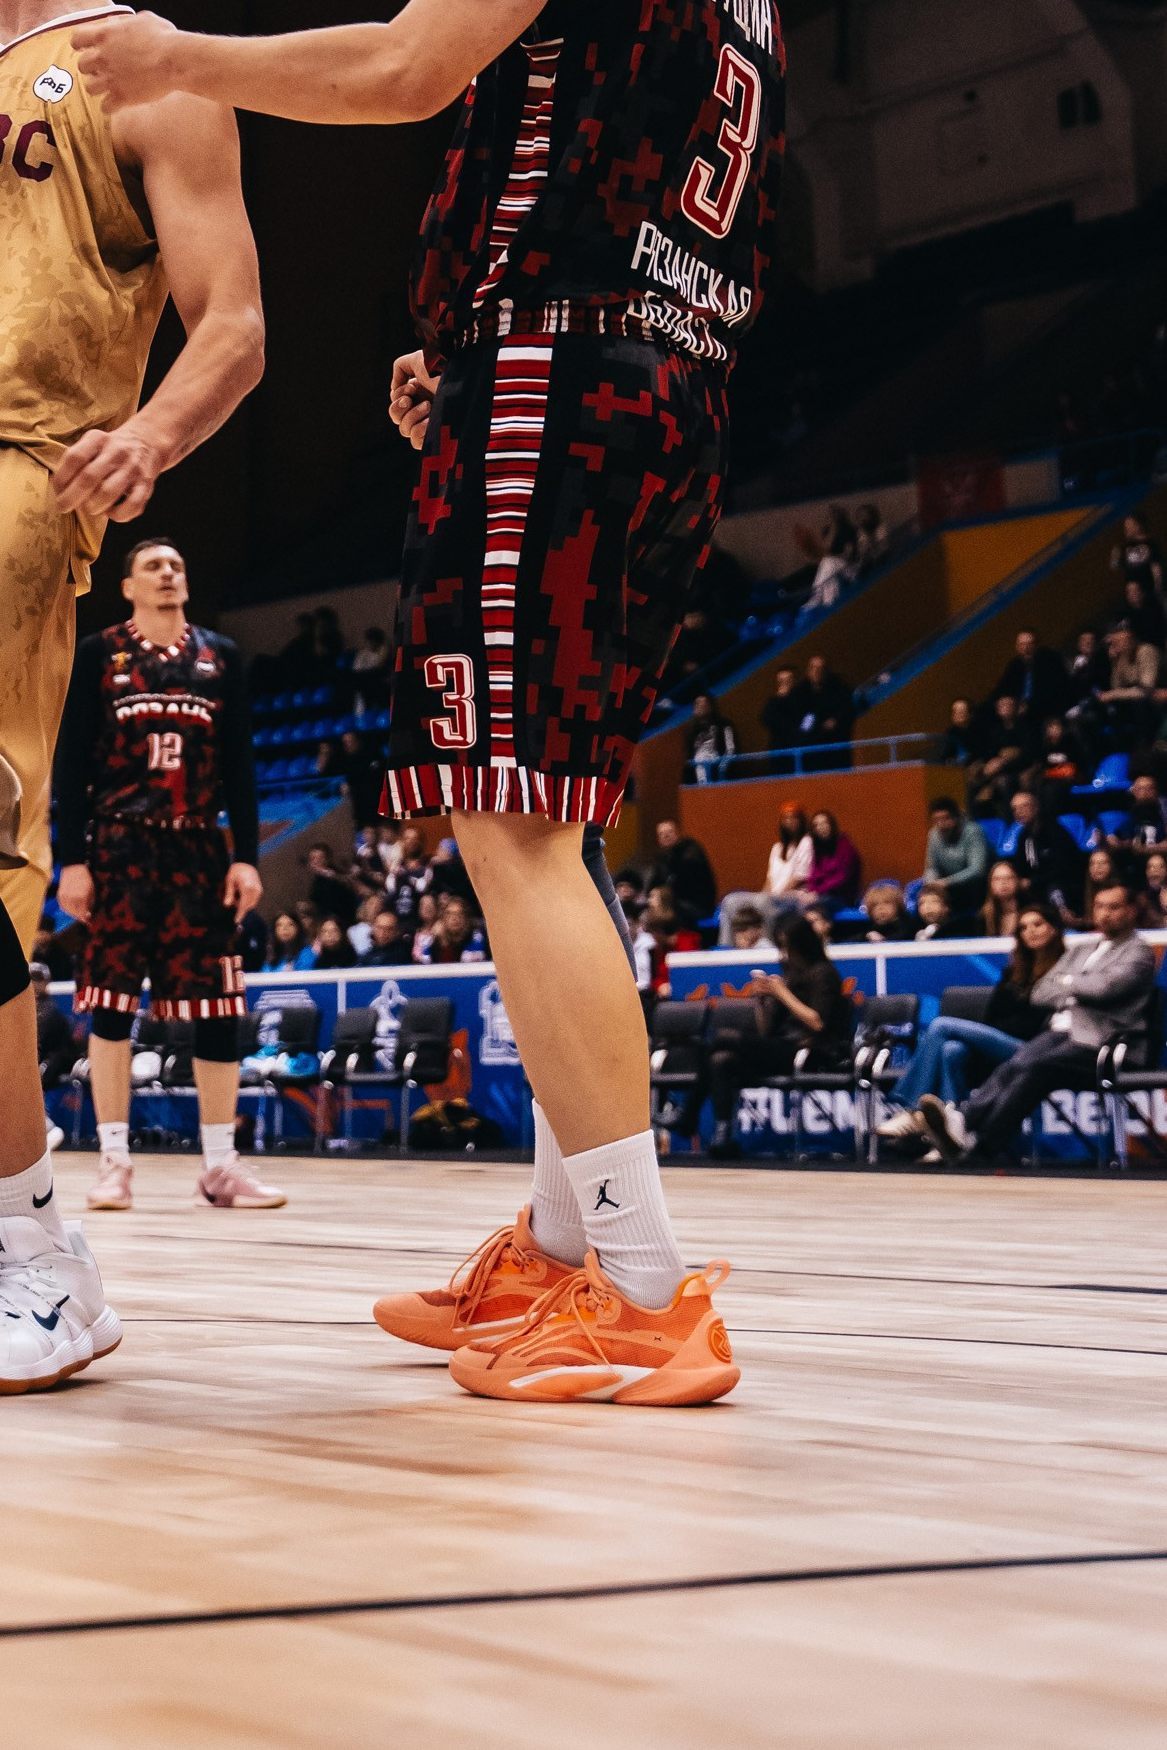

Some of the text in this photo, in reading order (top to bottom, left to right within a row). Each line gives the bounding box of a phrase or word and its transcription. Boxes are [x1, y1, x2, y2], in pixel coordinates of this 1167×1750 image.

[681, 43, 762, 239] 3
[631, 221, 752, 329] РЯЗАНСКАЯ
[146, 732, 184, 771] 12
[424, 653, 477, 749] 3
